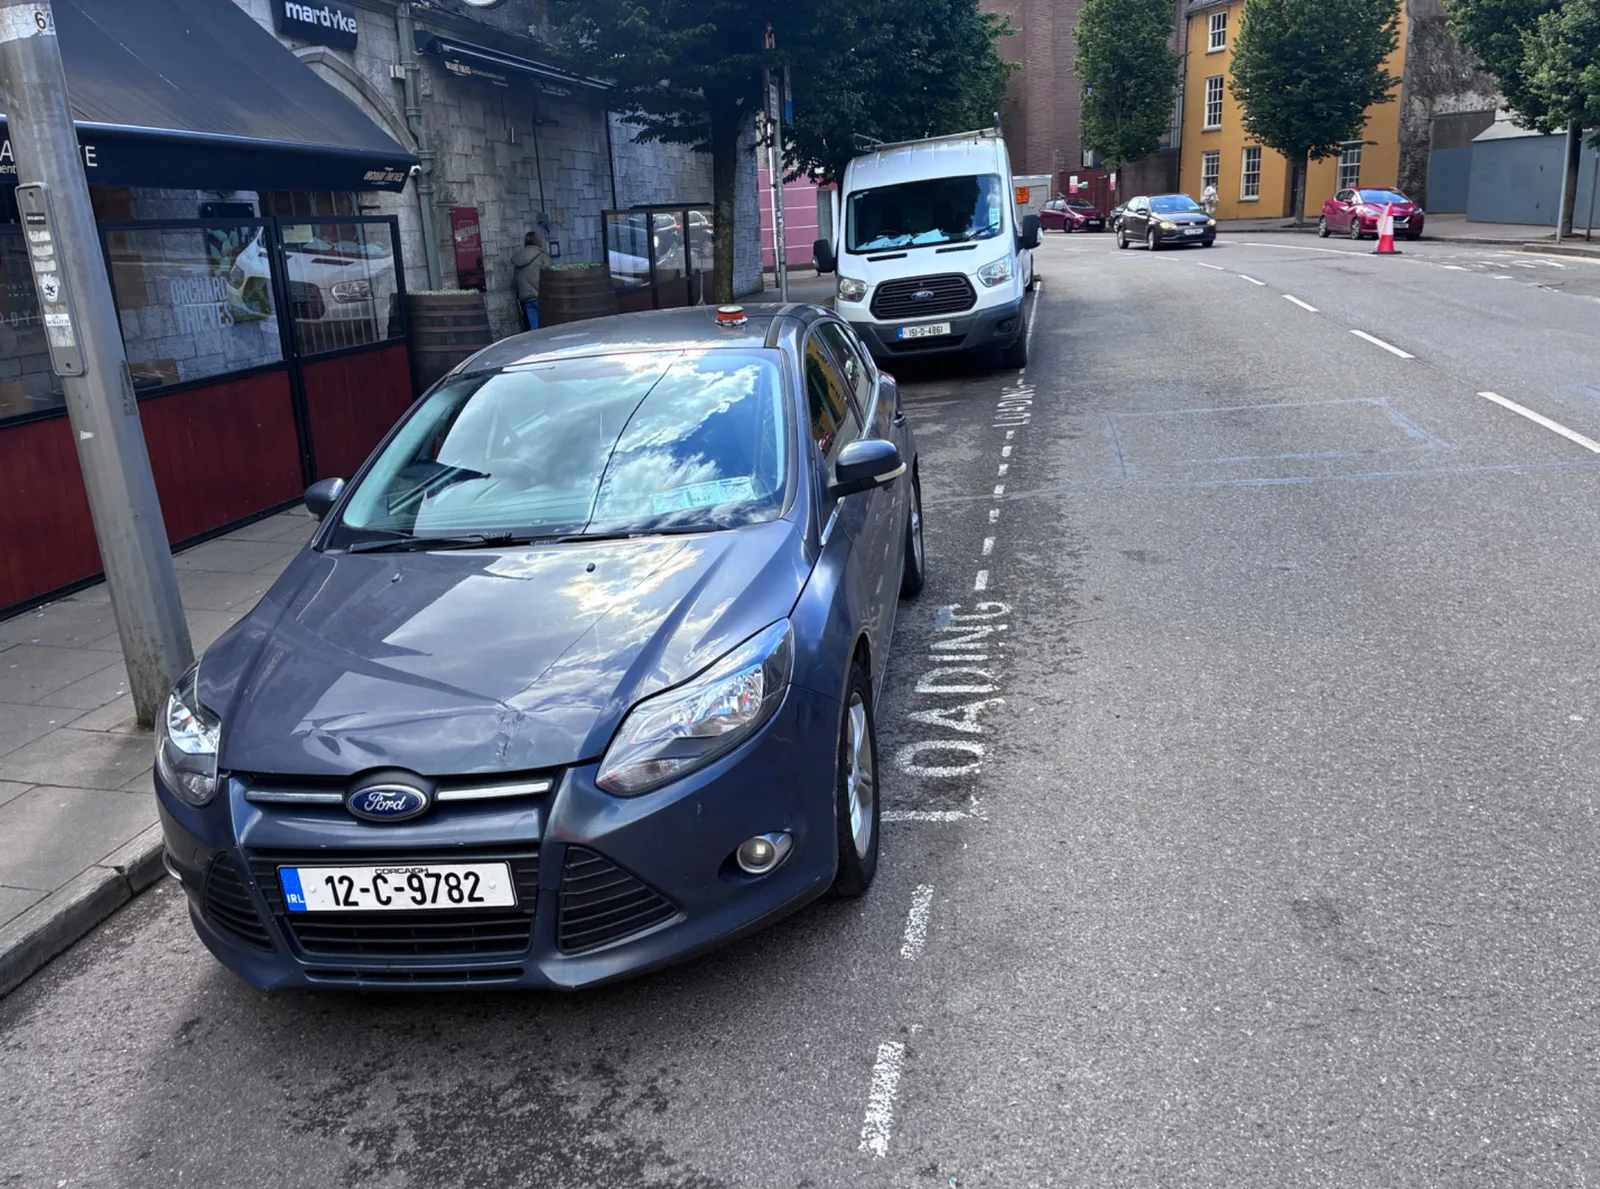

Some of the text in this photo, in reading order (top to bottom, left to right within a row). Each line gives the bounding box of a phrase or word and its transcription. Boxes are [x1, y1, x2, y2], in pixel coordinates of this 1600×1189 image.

[285, 1, 357, 33] mardyke
[170, 276, 229, 304] ORCHARD
[880, 601, 1012, 822] LOADING
[364, 791, 407, 811] Ford
[375, 867, 429, 875] CORCAIGH
[286, 894, 306, 904] IRL
[325, 871, 484, 907] 12-C-9782
